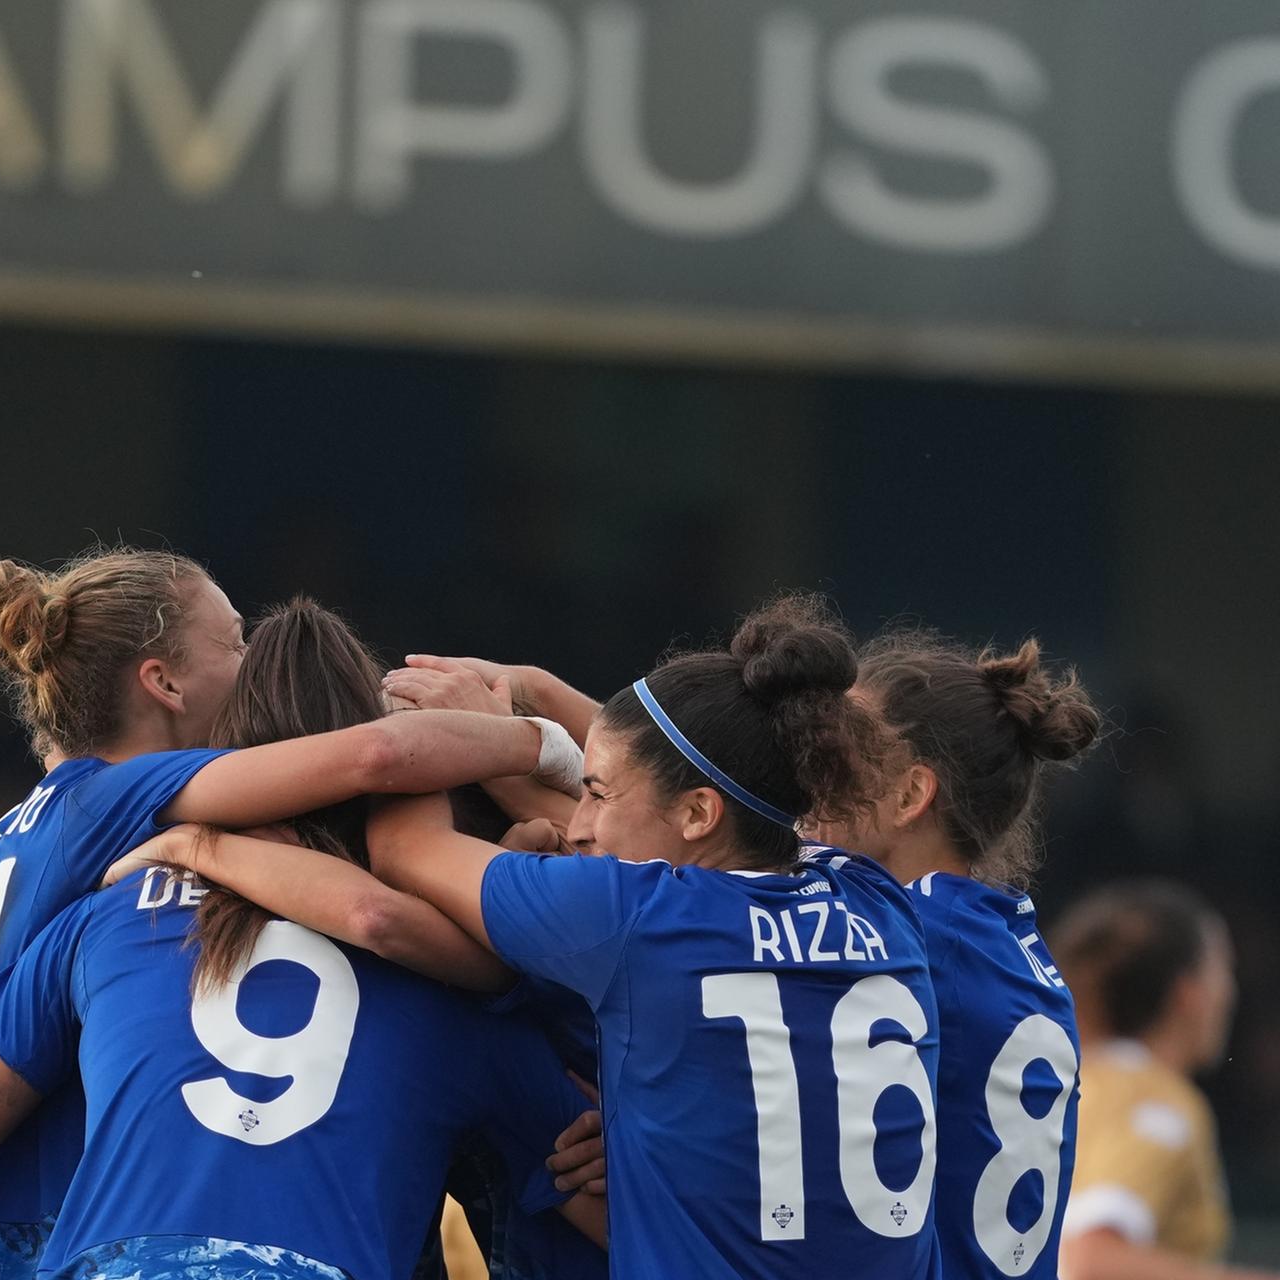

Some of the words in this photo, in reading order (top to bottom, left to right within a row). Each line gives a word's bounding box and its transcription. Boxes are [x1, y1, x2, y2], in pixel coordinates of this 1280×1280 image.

[181, 920, 360, 1146] 9
[749, 901, 889, 963] RIZZA
[701, 972, 938, 1241] 16
[973, 1013, 1079, 1278] 8
